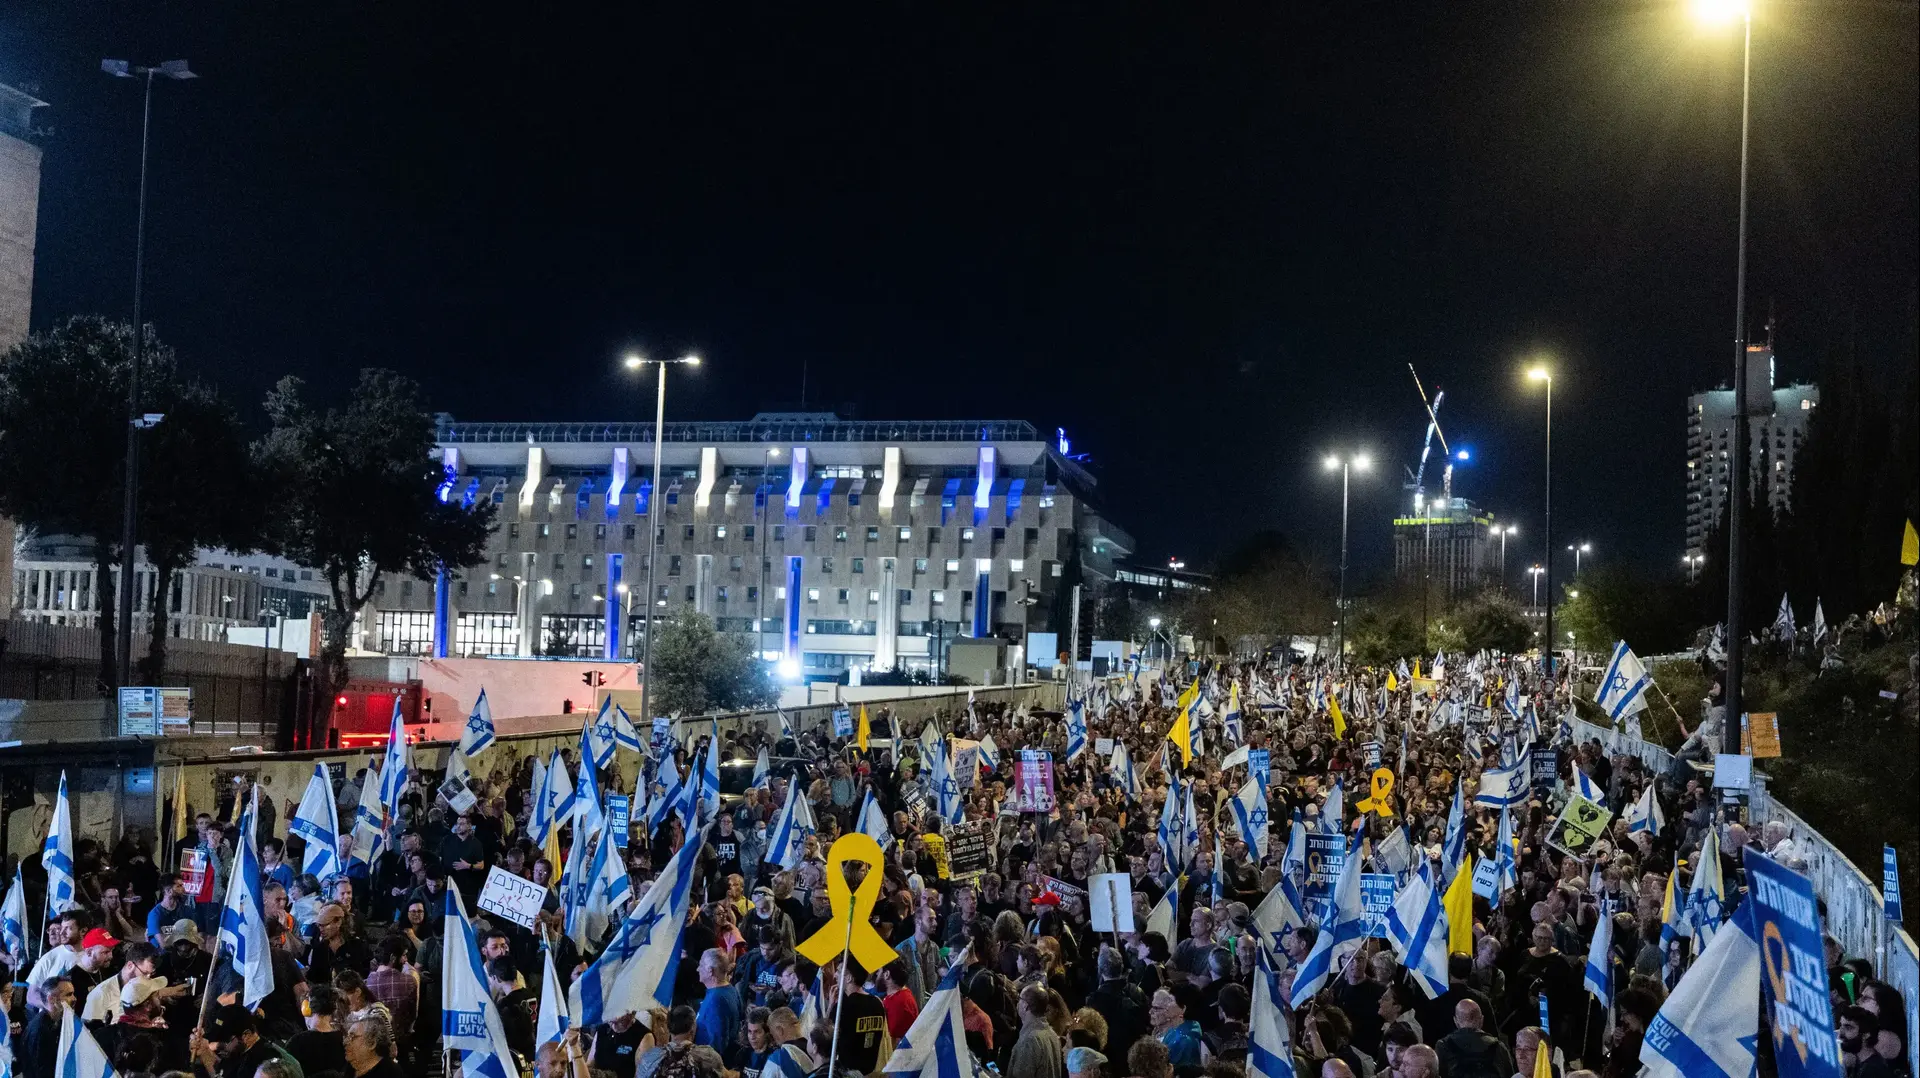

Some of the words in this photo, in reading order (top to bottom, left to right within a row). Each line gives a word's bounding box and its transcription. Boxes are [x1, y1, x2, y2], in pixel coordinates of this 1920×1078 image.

[1309, 839, 1324, 849] הרוב
[1324, 840, 1344, 850] אנחנו
[1324, 855, 1343, 864] בעד
[1373, 880, 1393, 890] אנחנו
[1752, 869, 1783, 914] הרוב
[1373, 895, 1391, 904] בעד
[1779, 884, 1816, 932] אנחנו
[1789, 942, 1824, 992] בעד
[1783, 968, 1829, 1027] עסקת
[1774, 999, 1836, 1068] חטופים
